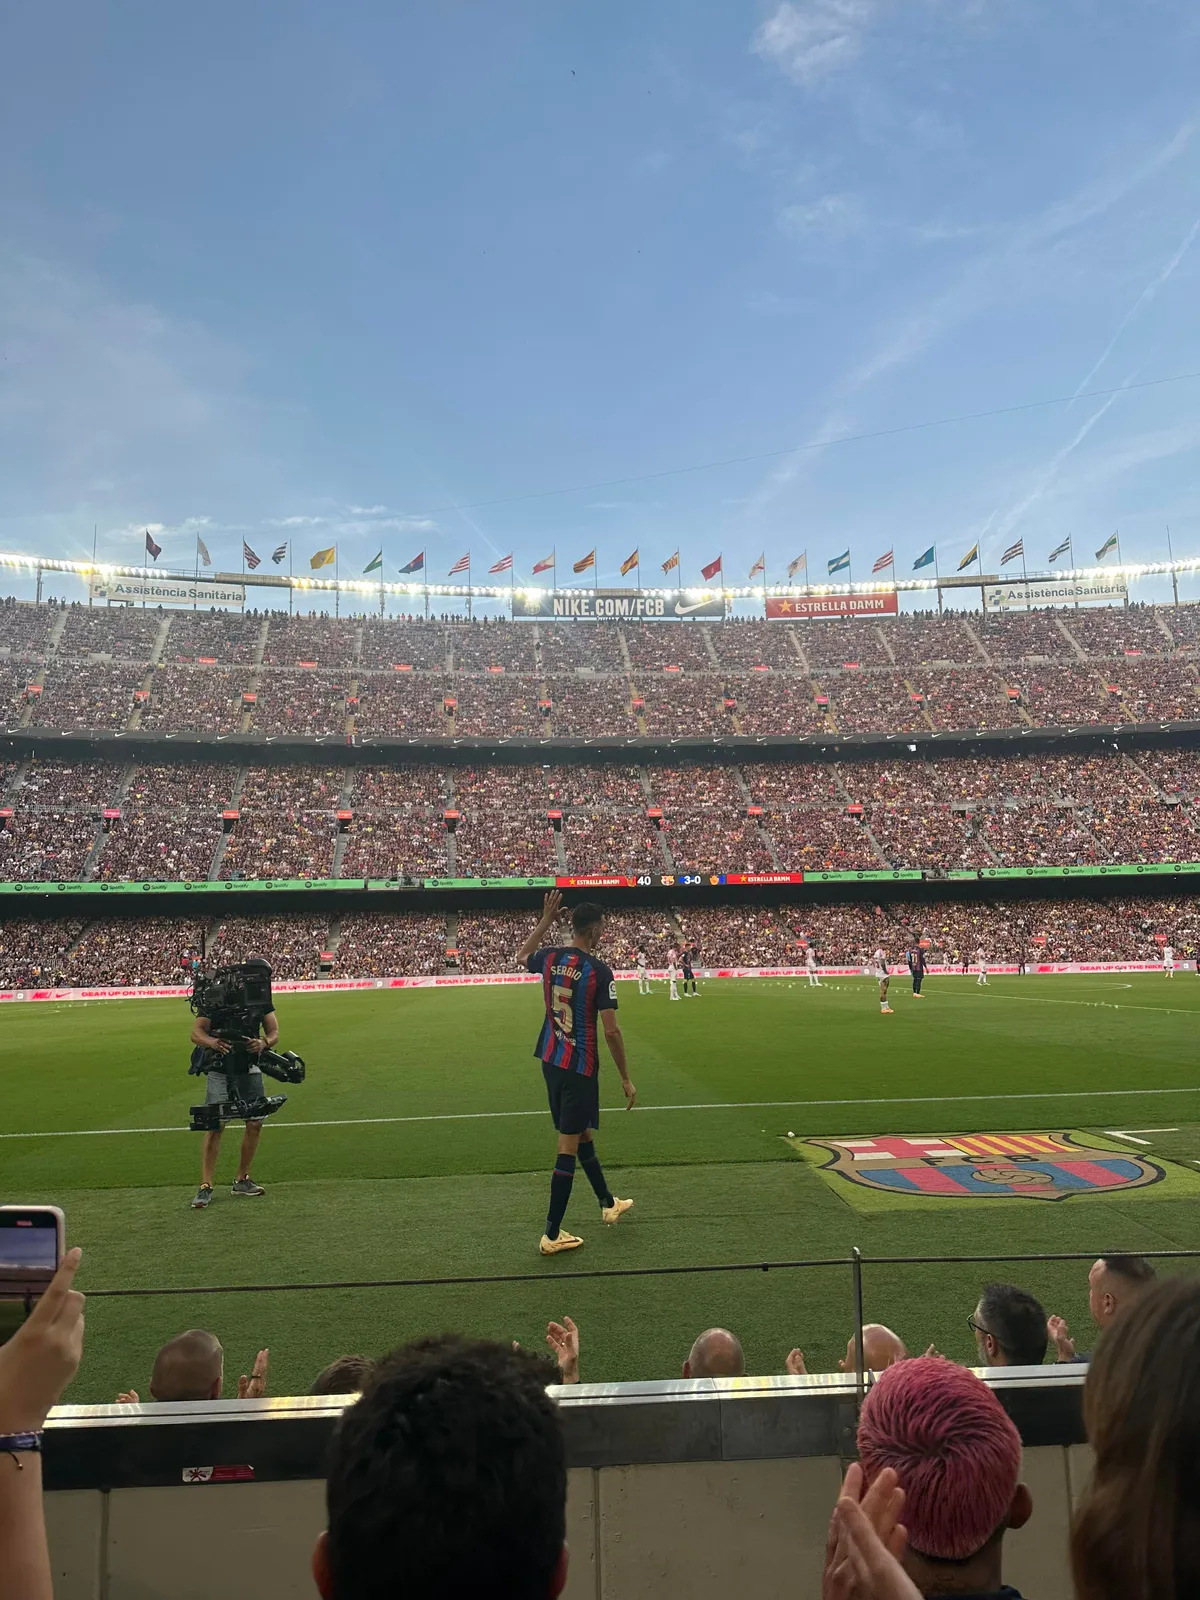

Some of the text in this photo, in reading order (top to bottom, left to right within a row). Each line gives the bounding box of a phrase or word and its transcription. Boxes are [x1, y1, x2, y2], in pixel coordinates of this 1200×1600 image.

[553, 599, 665, 615] NIKE.COM/FCB
[795, 599, 884, 612] ESTRELLA DAMM
[637, 876, 651, 885] 40
[684, 876, 701, 884] 3-0
[551, 966, 582, 980] SERGIO
[551, 985, 572, 1033] 5
